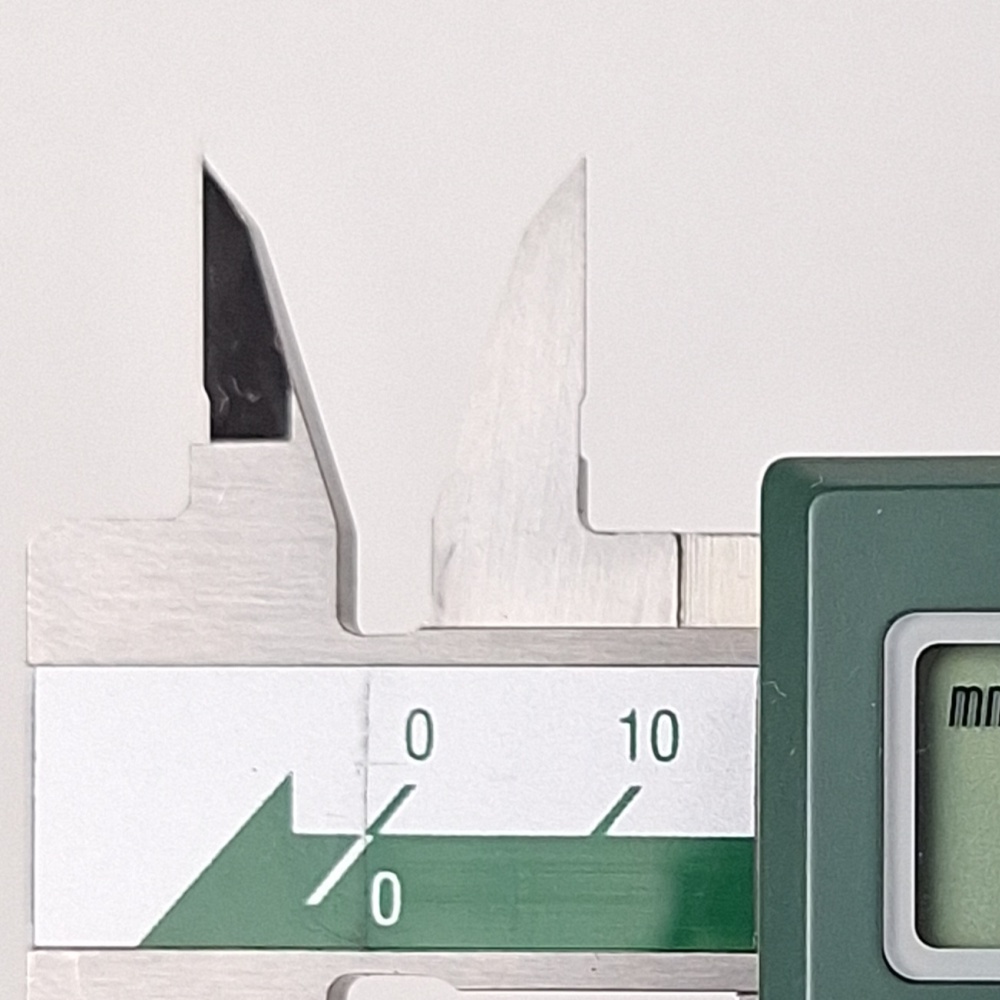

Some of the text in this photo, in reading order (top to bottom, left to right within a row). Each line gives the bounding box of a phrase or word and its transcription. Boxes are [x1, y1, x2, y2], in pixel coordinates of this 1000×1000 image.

[405, 708, 680, 762] 0 10
[370, 871, 402, 925] 0
